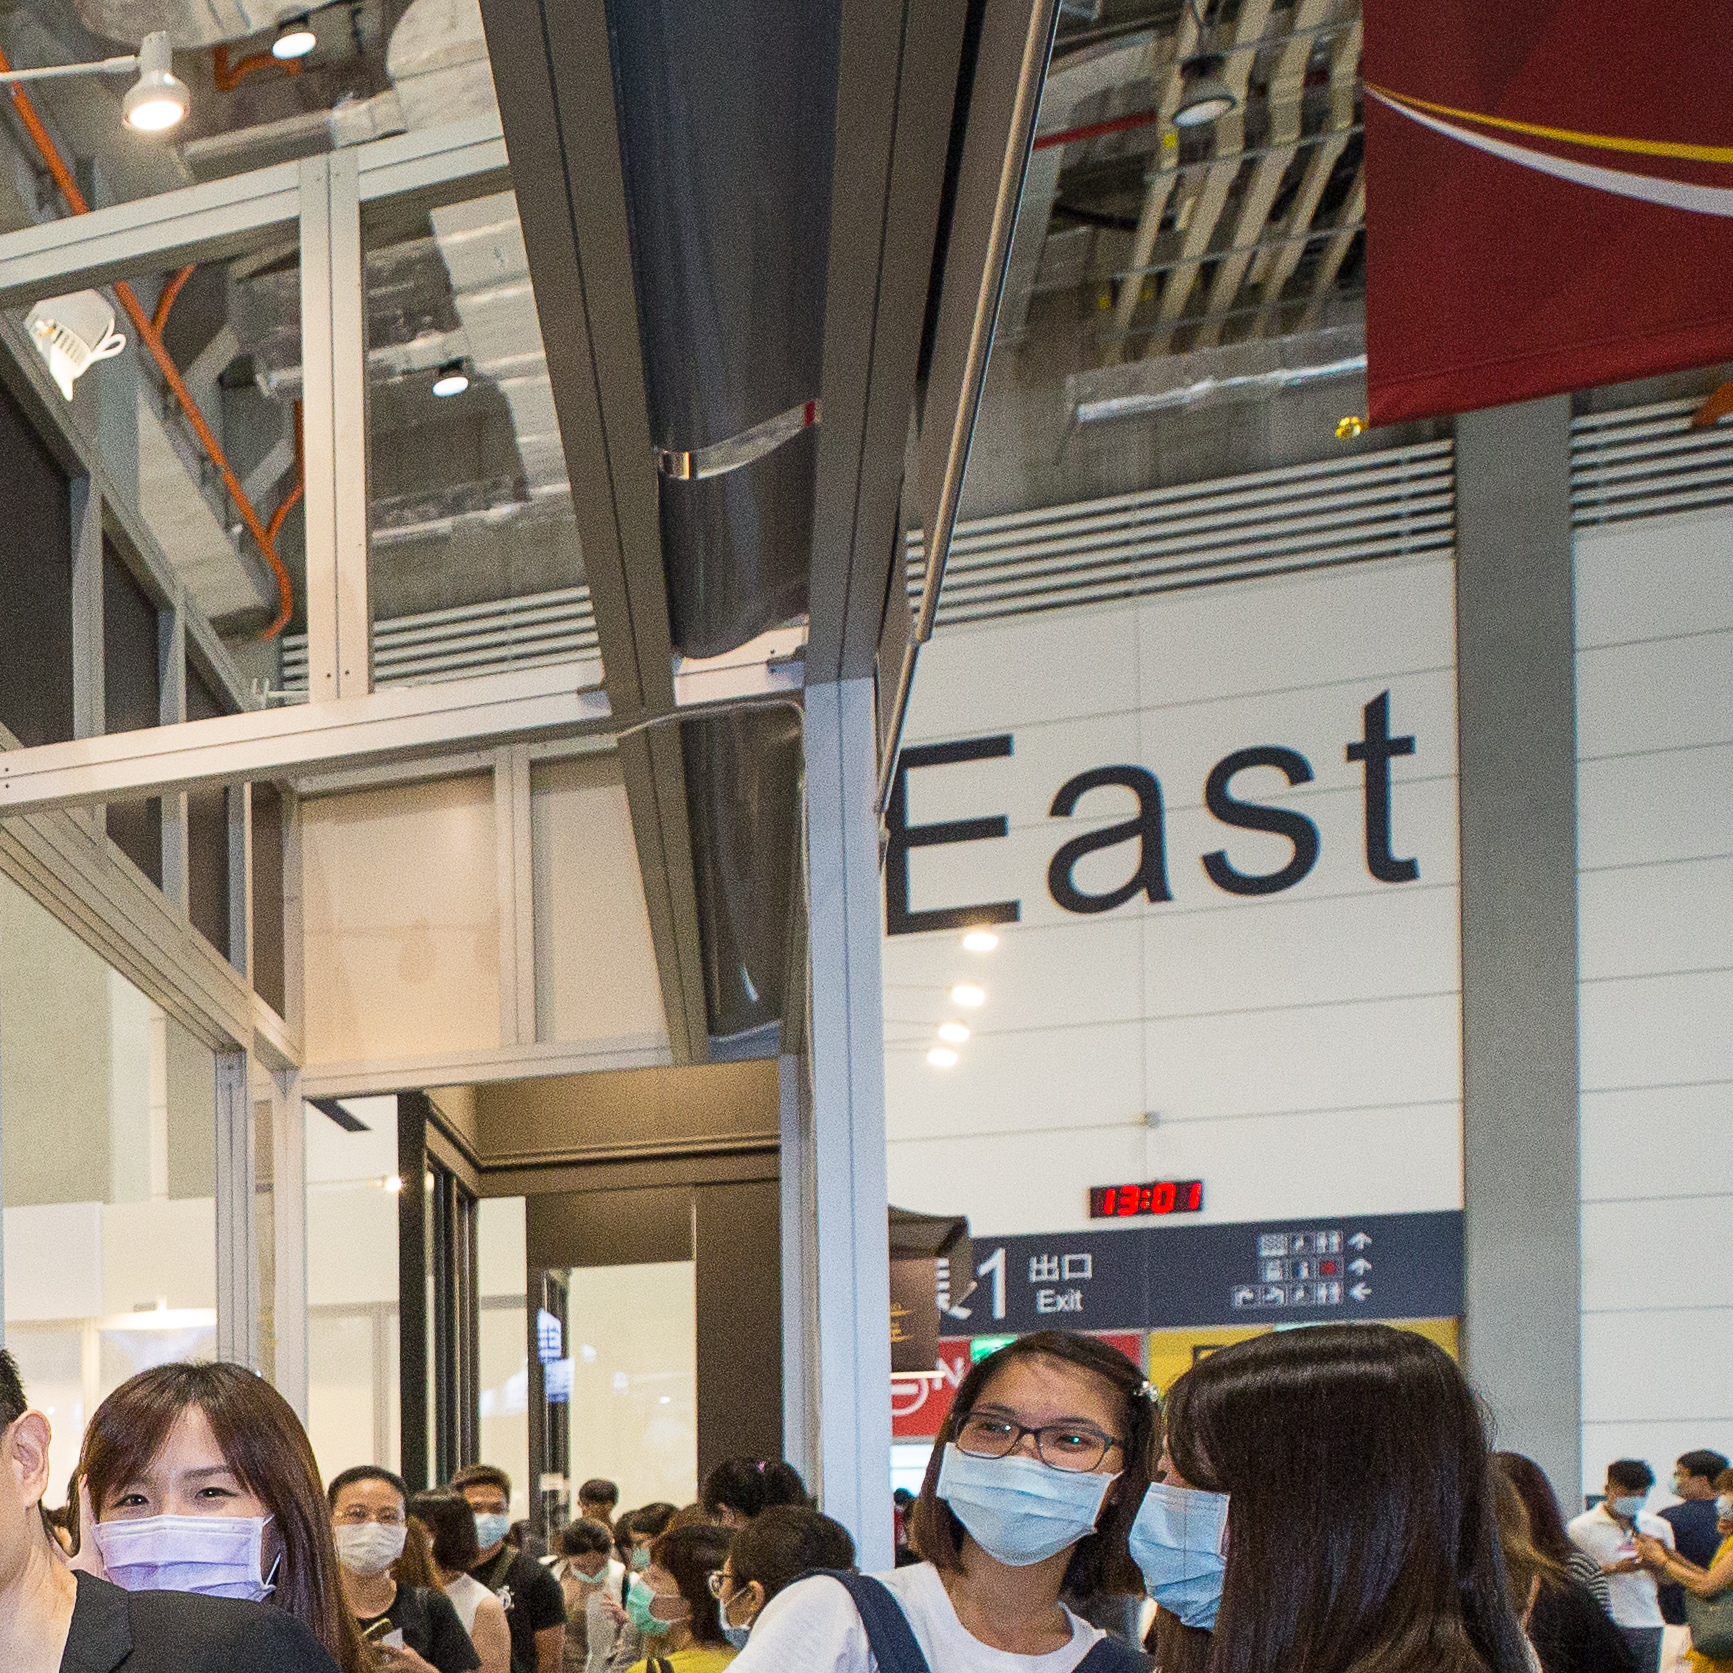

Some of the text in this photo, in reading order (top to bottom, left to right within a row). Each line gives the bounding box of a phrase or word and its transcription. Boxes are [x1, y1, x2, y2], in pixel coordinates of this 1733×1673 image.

[885, 690, 1421, 936] East
[1104, 1182, 1202, 1217] 13:01
[1028, 1252, 1094, 1284] 出口
[1036, 1289, 1084, 1314] Exit
